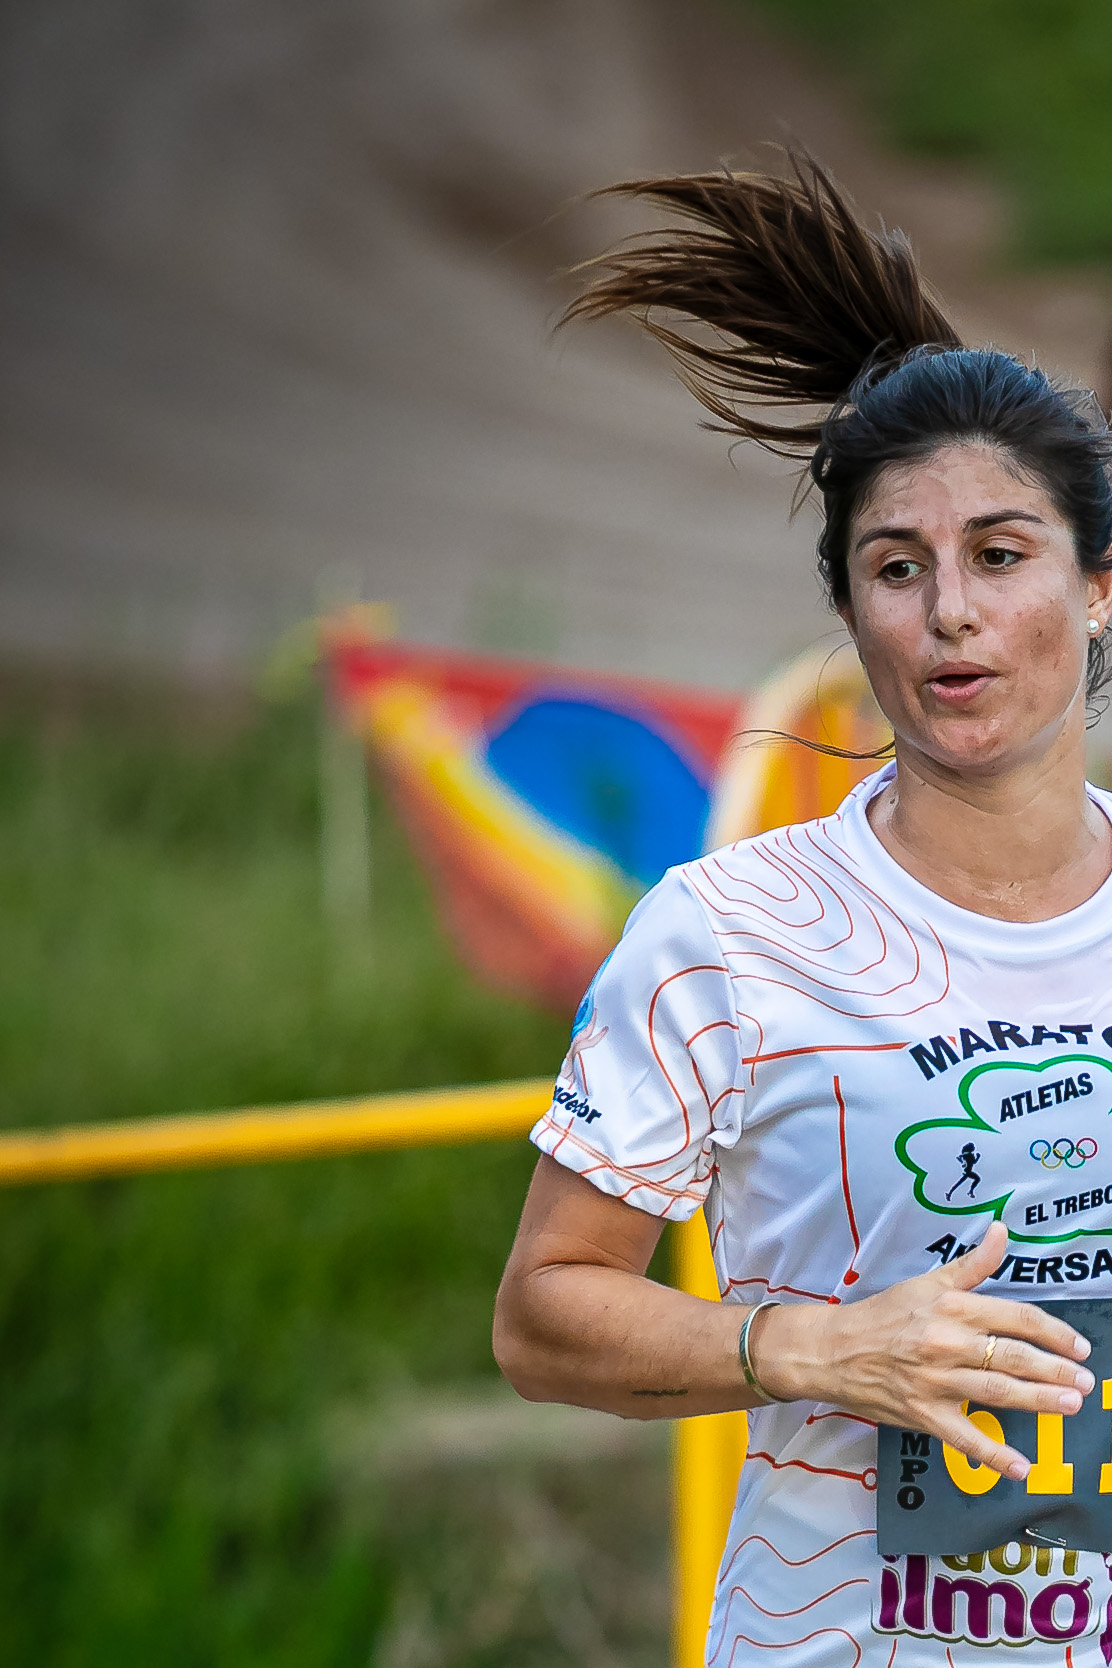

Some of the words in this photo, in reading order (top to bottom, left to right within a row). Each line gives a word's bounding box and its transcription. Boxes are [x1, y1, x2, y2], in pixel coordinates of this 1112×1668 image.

[999, 1072, 1094, 1123] ATLETAS
[1025, 1204, 1049, 1226] EL
[896, 1432, 931, 1511] MPO
